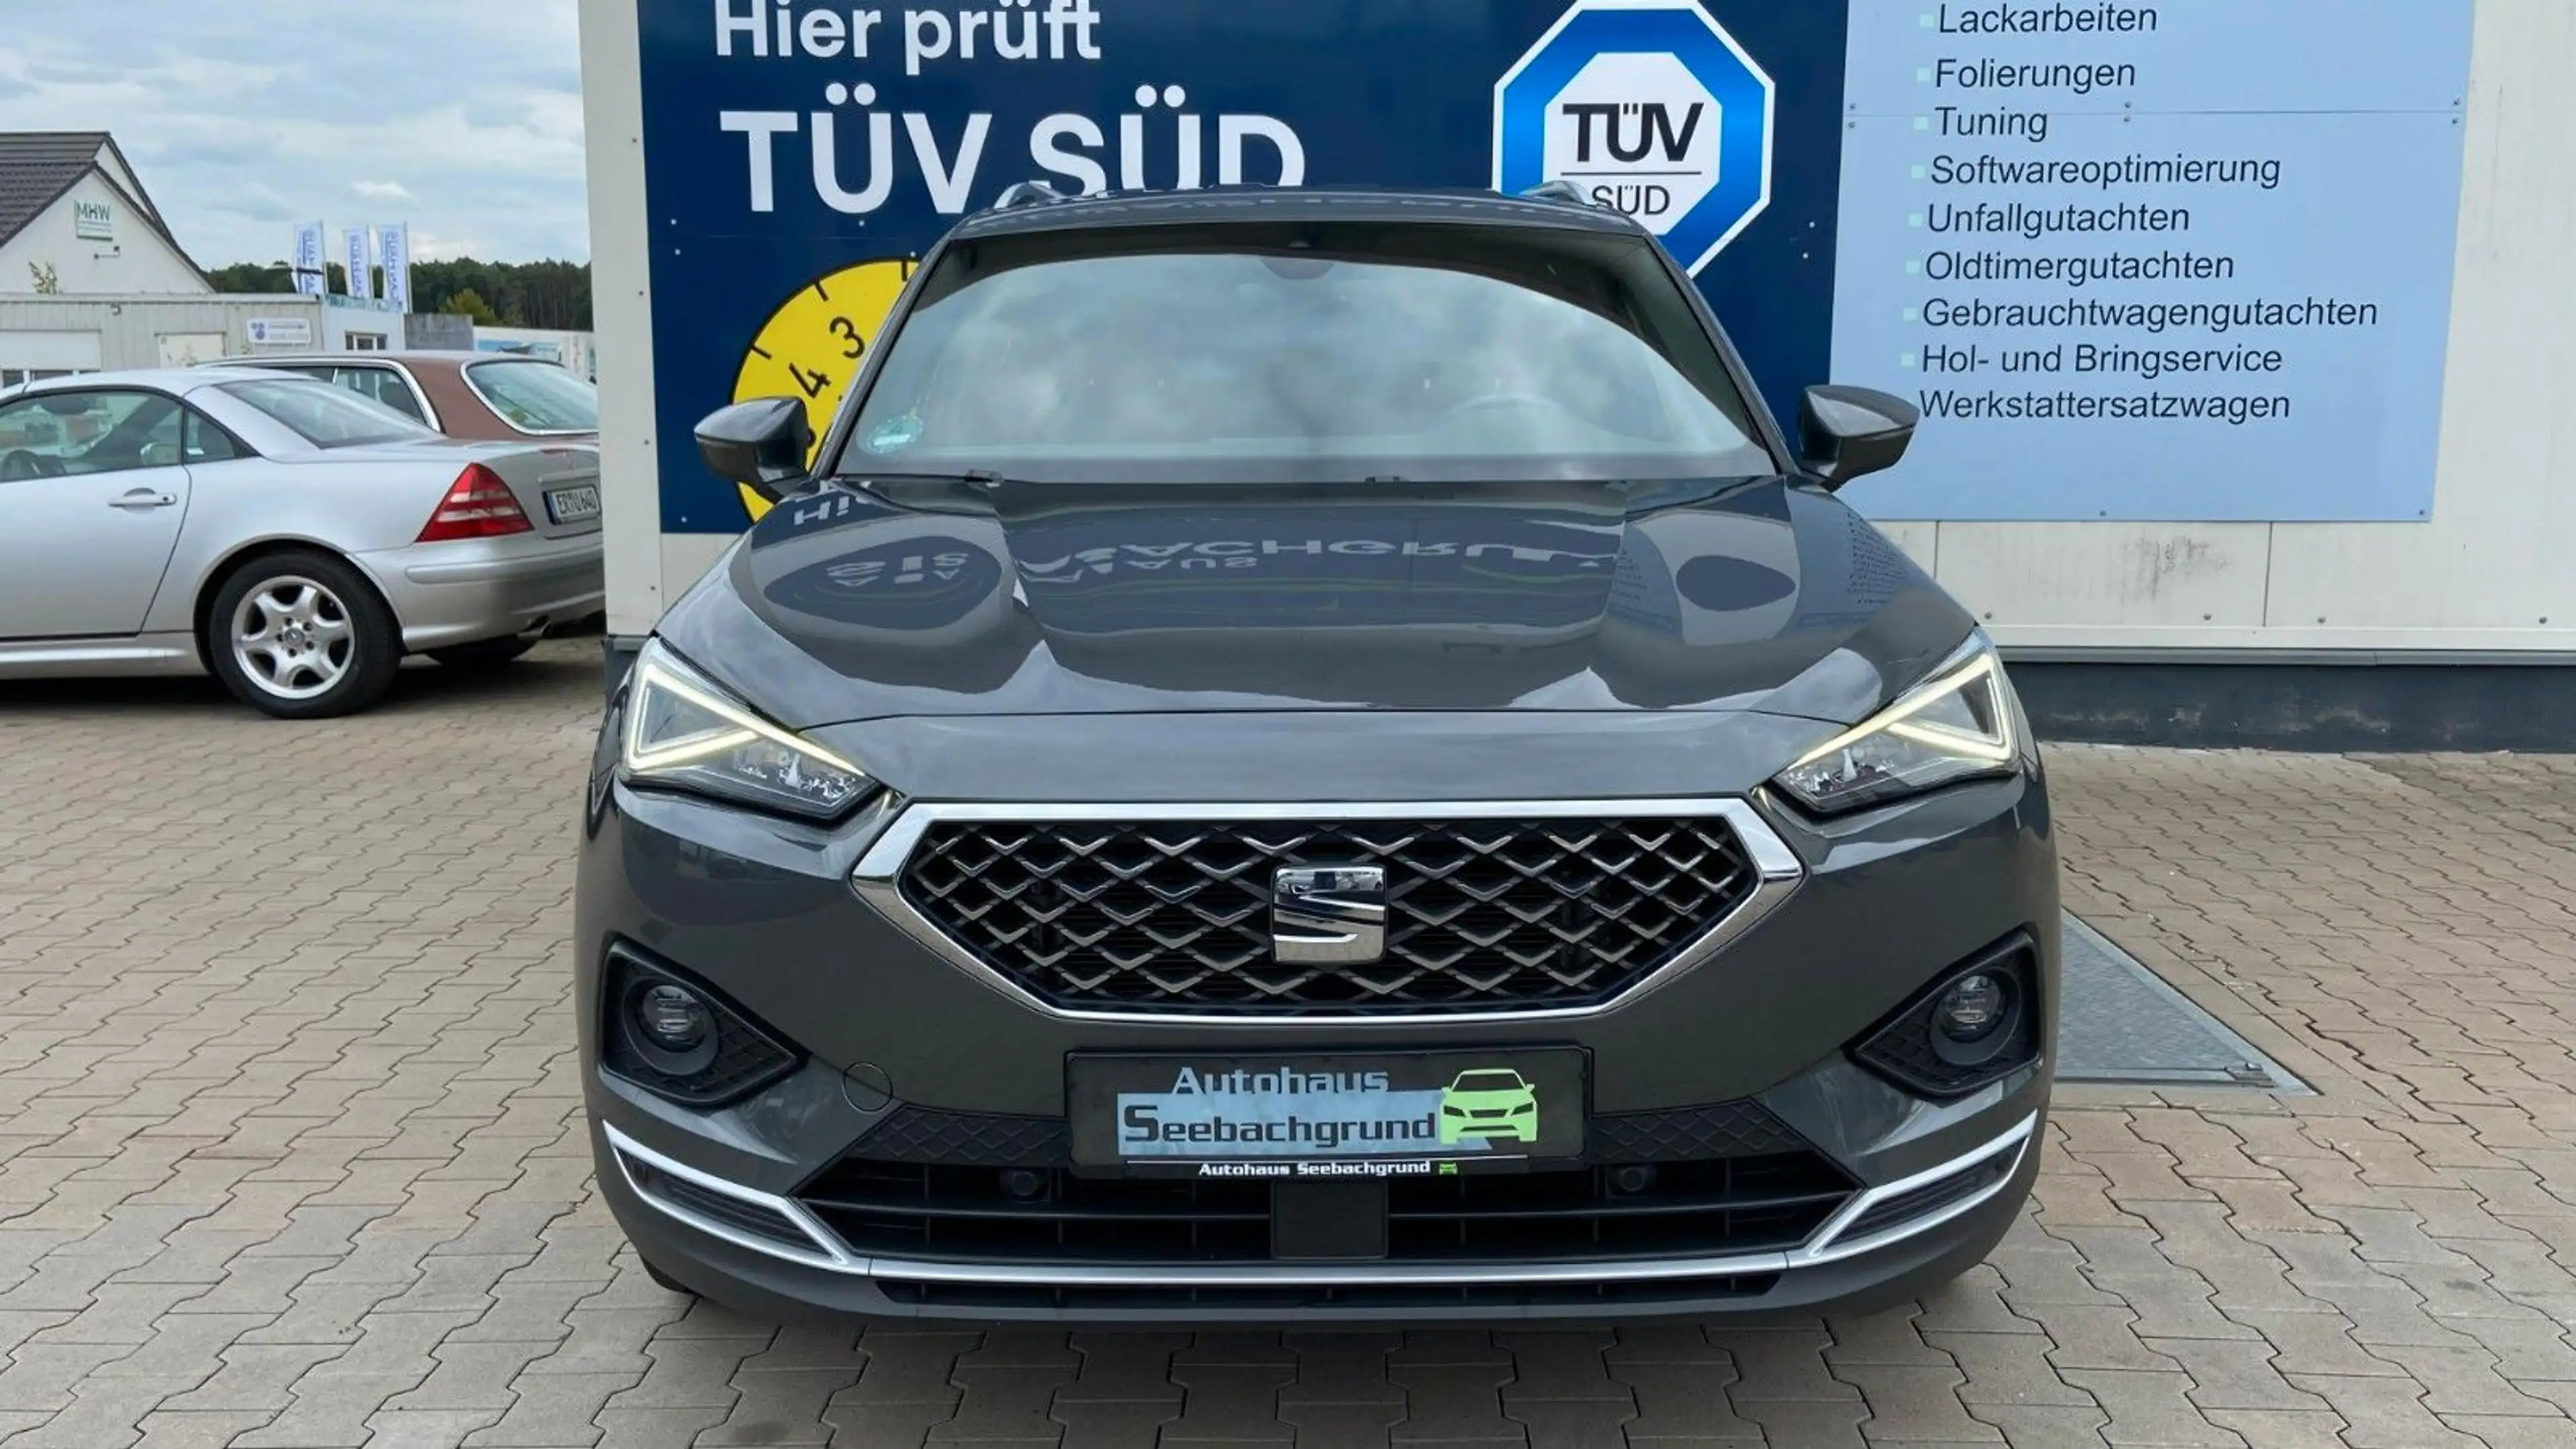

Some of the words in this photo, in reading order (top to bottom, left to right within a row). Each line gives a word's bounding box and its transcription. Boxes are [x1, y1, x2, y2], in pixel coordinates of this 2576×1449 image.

[1937, 3, 2157, 34] Lackarbeiten
[713, 0, 881, 58] Hier
[904, 0, 1102, 76] prüft
[1936, 59, 2136, 95] Folierungen
[1562, 103, 1705, 162] TÜV
[1935, 107, 2048, 144] Tuning
[719, 83, 993, 215] TÜV
[1030, 85, 1305, 196] SÜD
[1931, 156, 2281, 191] Softwareoptimierung
[1592, 185, 1670, 215] SÜD
[1927, 204, 2190, 240] Unfallgutachten
[1925, 251, 2235, 288] Oldtimergutachten
[1923, 297, 2377, 334] Gebrauchtwagengutachten
[829, 315, 865, 359] 3
[788, 362, 832, 398] 4
[1922, 345, 1990, 373] Hol-
[2002, 345, 2062, 374] und
[2074, 344, 2283, 380] Bringservice
[1919, 390, 2290, 426] Werkstattersatzwagen
[1172, 1066, 1389, 1095] Autohaus
[1124, 1104, 1436, 1148] Seebachgrund
[1199, 1163, 1291, 1176] Autohaus
[1297, 1161, 1431, 1177] Seebachgrund
